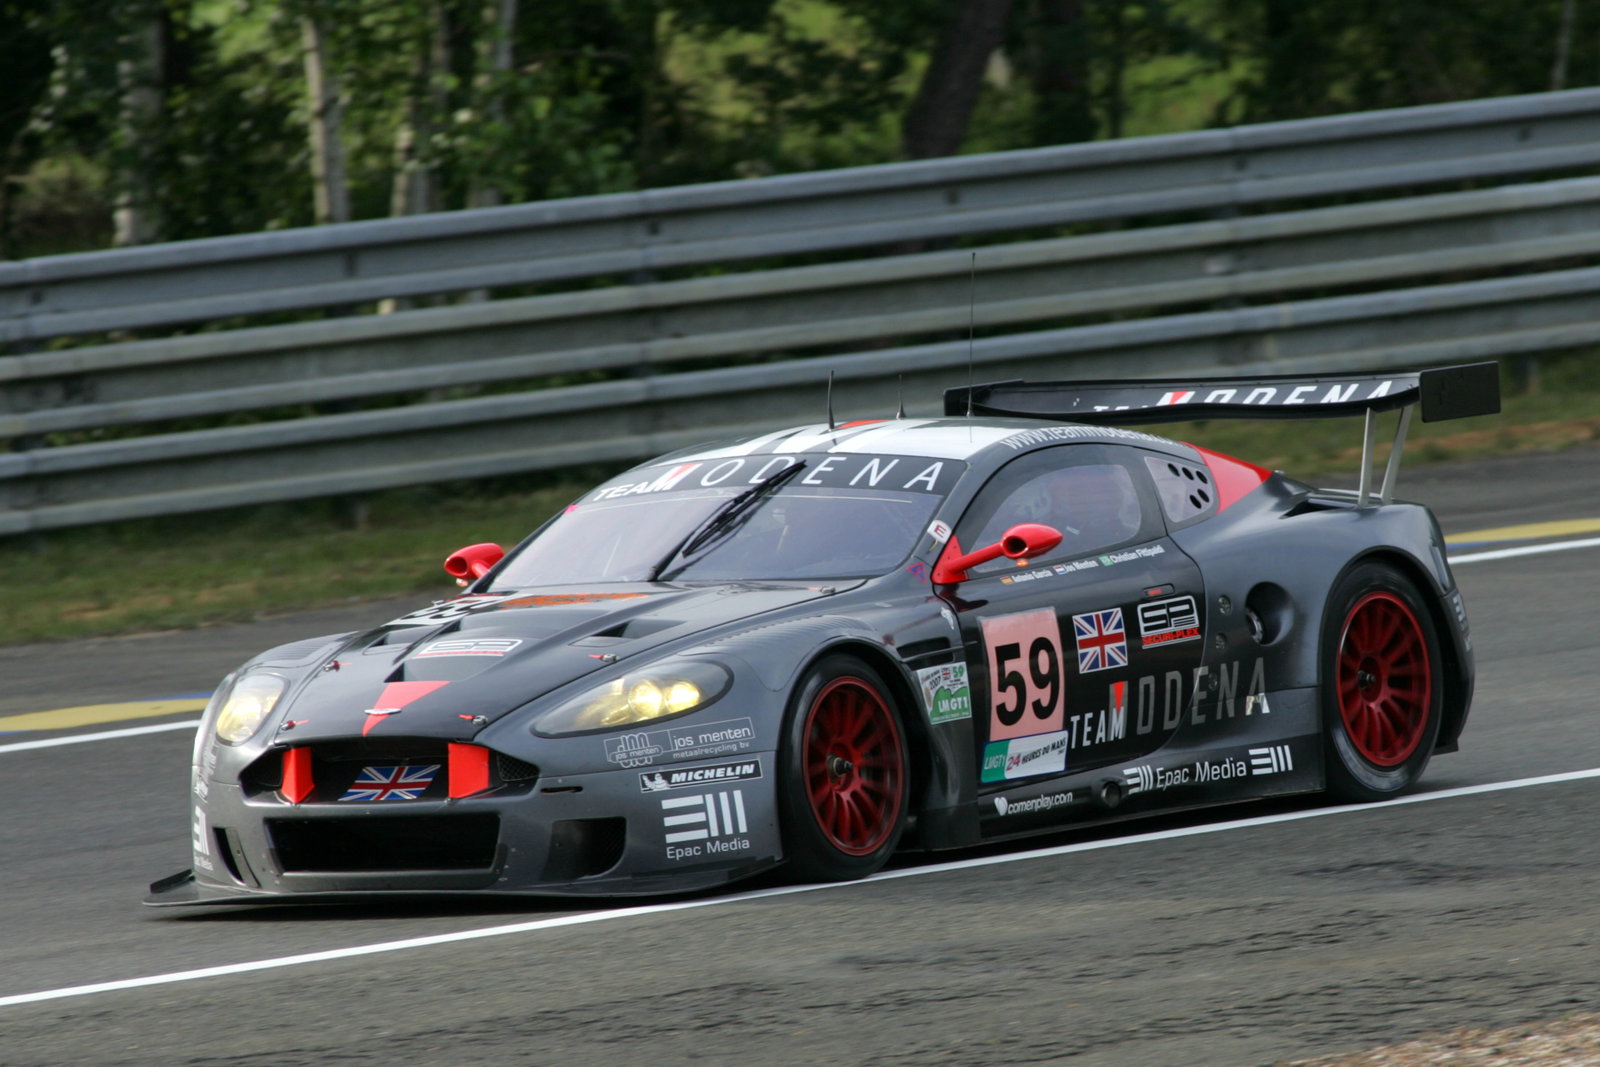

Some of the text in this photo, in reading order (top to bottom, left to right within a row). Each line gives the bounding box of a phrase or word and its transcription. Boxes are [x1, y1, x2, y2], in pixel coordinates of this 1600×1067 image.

[952, 665, 965, 678] 59
[995, 637, 1060, 726] 59
[674, 727, 751, 751] jos menten
[1071, 706, 1124, 749] TEAM
[671, 764, 755, 783] MICHELIN
[1006, 753, 1022, 771] 24
[1156, 758, 1247, 791] Epac Media
[666, 838, 750, 860] Epac Media
